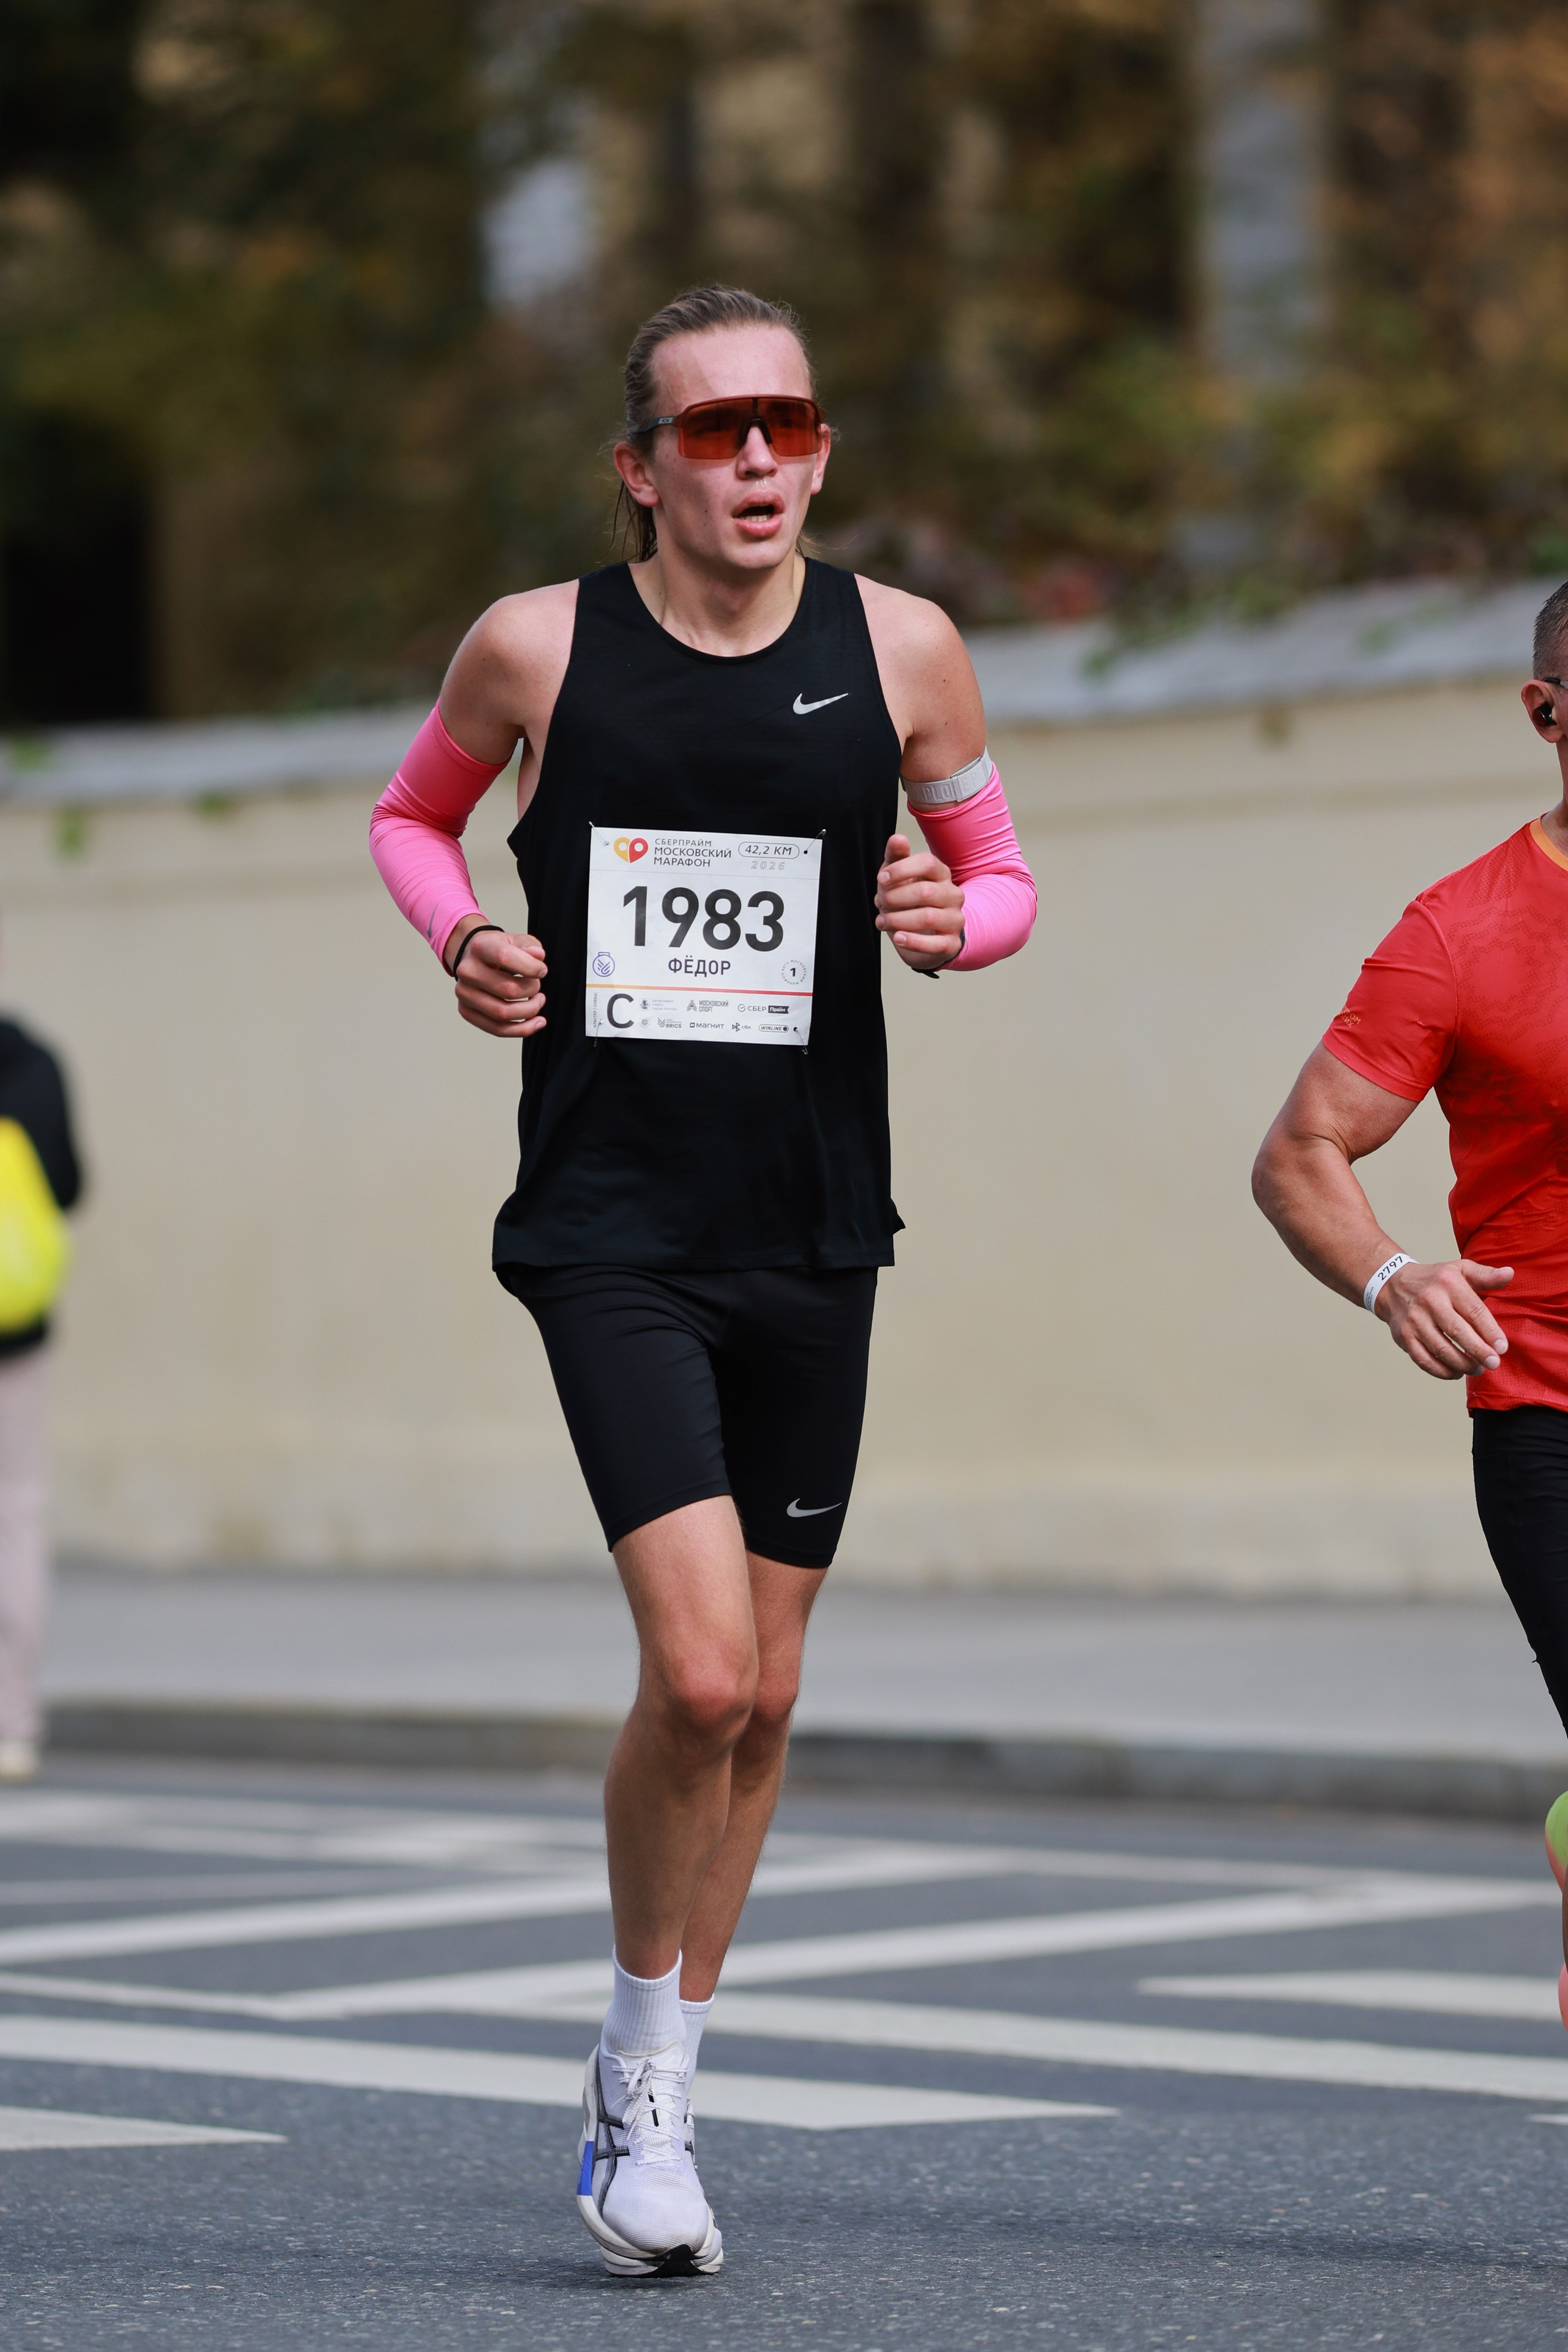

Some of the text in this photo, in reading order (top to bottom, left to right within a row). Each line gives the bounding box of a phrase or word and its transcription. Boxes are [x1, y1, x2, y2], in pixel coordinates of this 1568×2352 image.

[655, 838, 712, 847] СБЕРПРАЙМ
[654, 847, 731, 858] МОСКОВСКИЙ
[745, 845, 792, 855] 42,2 КМ
[654, 857, 710, 867] МАРАФОН
[750, 861, 785, 870] 2026
[623, 886, 785, 952] 1983
[668, 955, 731, 978] ФЁДОР
[790, 967, 796, 977] 1
[1378, 1256, 1403, 1281] 2797
